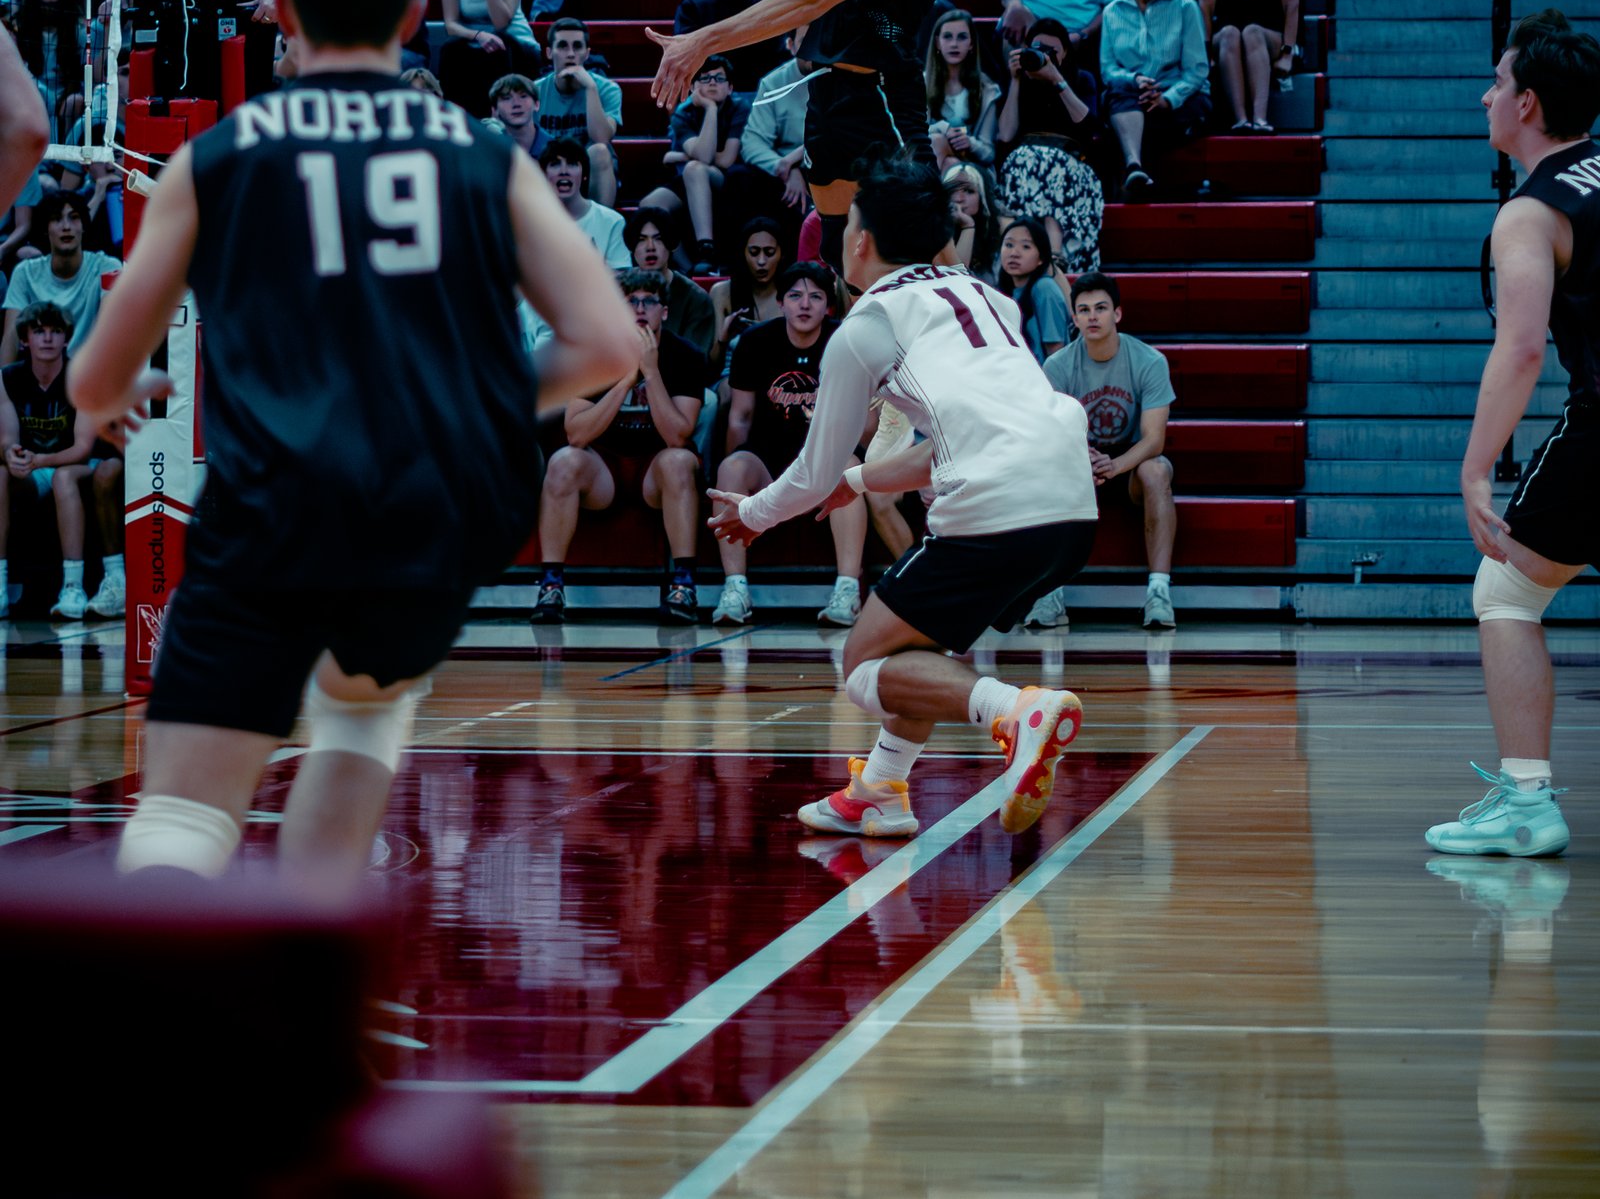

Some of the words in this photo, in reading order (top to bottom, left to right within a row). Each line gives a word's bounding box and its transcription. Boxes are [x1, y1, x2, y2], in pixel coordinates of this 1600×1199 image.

[235, 88, 474, 150] NORTH
[1554, 155, 1600, 196] NO
[297, 150, 442, 276] 19
[932, 282, 1021, 349] 11
[149, 517, 167, 594] imports
